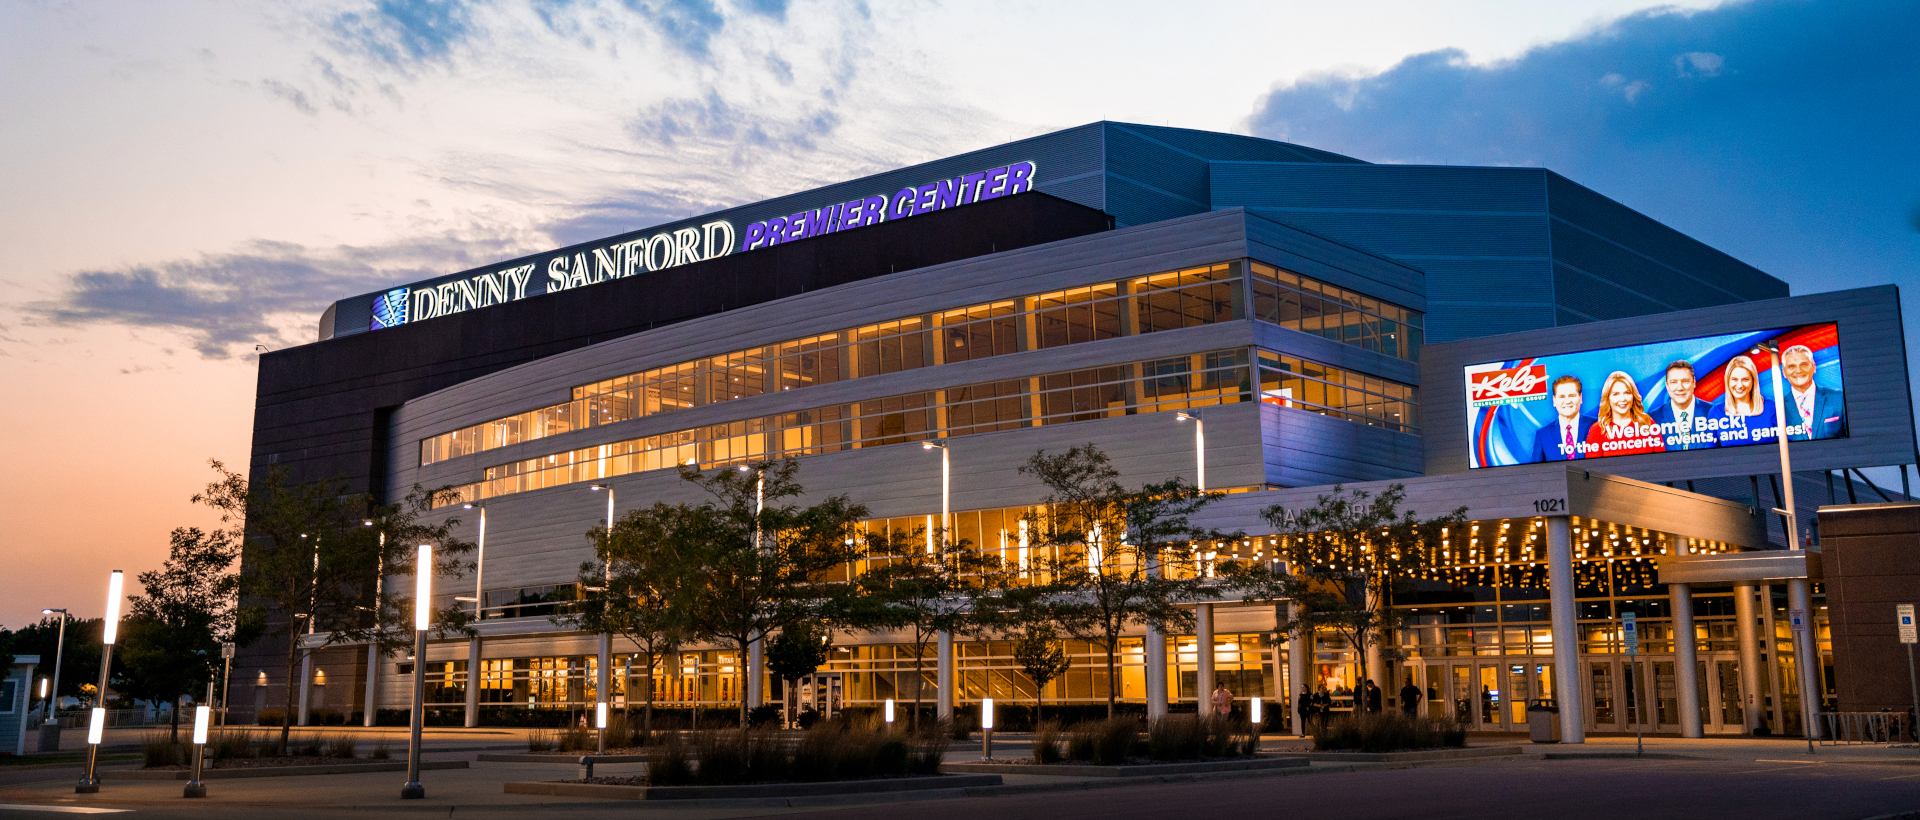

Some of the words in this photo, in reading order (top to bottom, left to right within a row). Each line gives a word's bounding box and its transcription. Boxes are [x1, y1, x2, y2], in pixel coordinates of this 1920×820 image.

[412, 263, 536, 322] DENNY
[547, 219, 735, 294] SANFORD
[742, 194, 888, 252] PREMIER
[888, 160, 1036, 221] CENTER
[1606, 421, 1690, 439] Welcome
[1694, 413, 1746, 432] Back!
[1558, 443, 1574, 455] To
[1576, 441, 1599, 454] the
[1602, 436, 1664, 452] concerts,
[1666, 431, 1717, 446] events,
[1720, 427, 1748, 441] and
[1532, 498, 1565, 512] 1021
